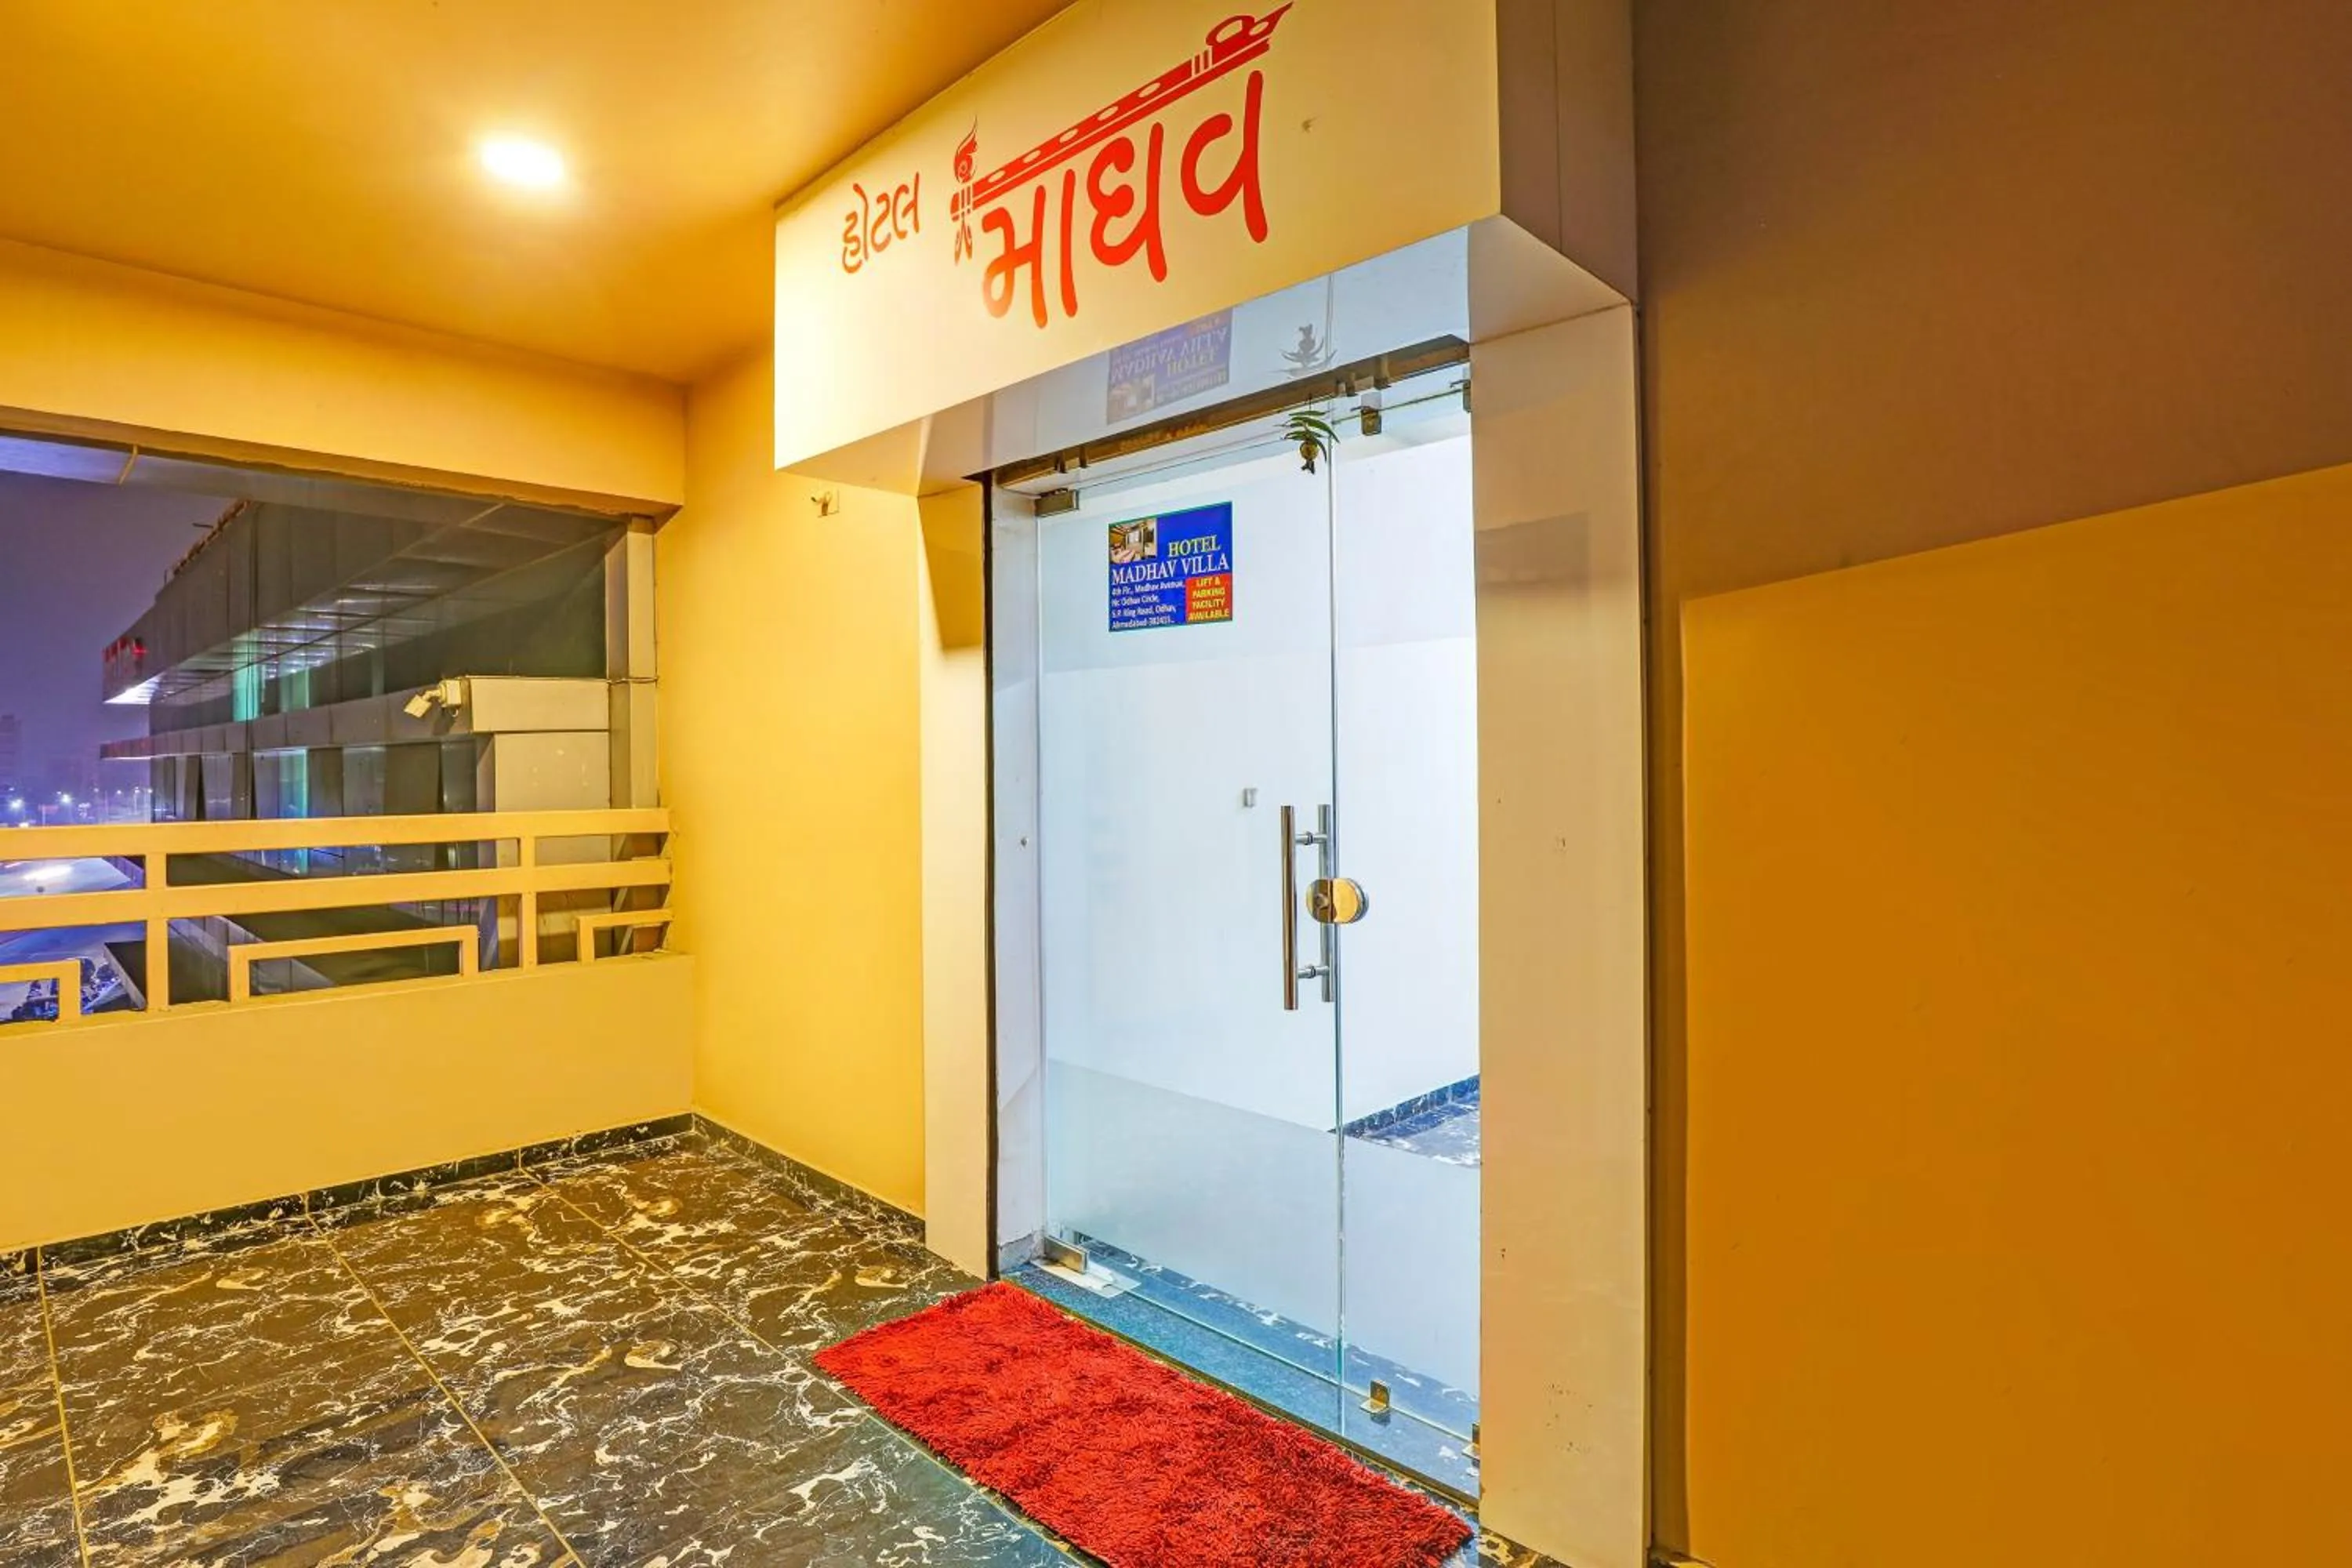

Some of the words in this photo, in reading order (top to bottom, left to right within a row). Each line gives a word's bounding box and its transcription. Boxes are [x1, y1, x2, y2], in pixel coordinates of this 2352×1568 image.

[842, 172, 920, 274] હોટલ
[1168, 535, 1221, 557] HOTEL
[1112, 561, 1177, 585] MADHAV
[1181, 554, 1229, 575] VILLA
[1192, 588, 1225, 598] PARKING
[1192, 598, 1225, 609] FACILITY
[1189, 609, 1229, 621] AVAILABLE
